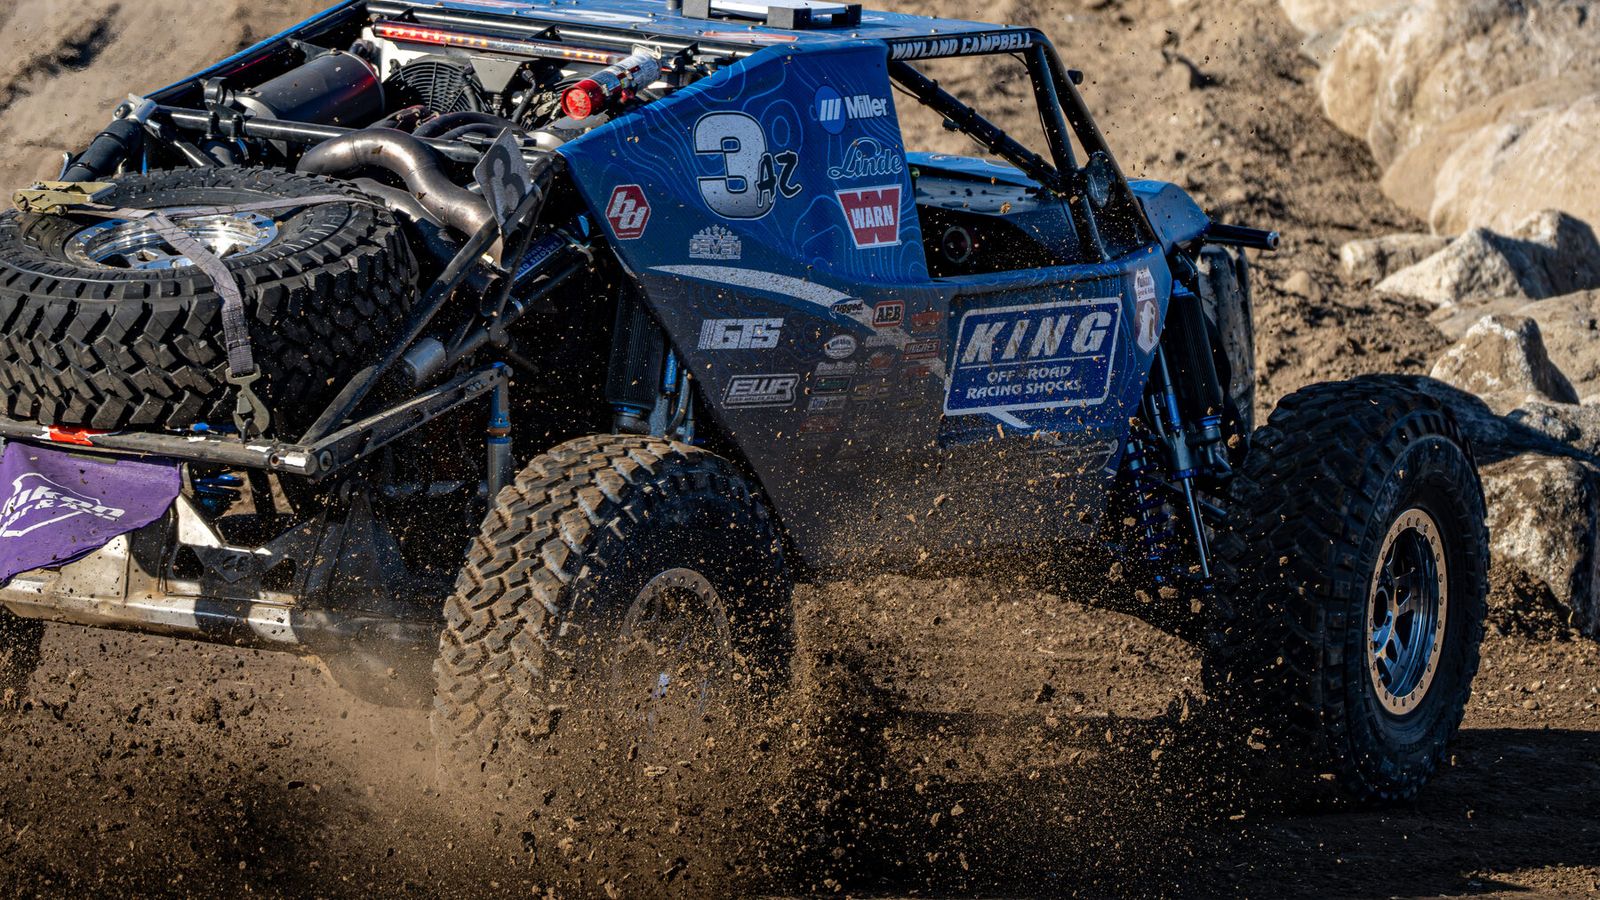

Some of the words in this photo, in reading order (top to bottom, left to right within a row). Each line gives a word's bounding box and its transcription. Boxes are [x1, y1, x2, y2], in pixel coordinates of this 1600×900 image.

[892, 39, 958, 59] WAYLAND
[960, 32, 1033, 54] CAMPBELL
[844, 95, 888, 119] Miller
[693, 109, 777, 221] 3
[827, 136, 902, 179] Linde
[850, 205, 894, 229] WARN
[961, 311, 1112, 364] KING
[987, 369, 1016, 384] OFF
[1027, 365, 1072, 381] ROAD
[966, 384, 1022, 400] RACING
[1025, 379, 1081, 395] SHOCKS
